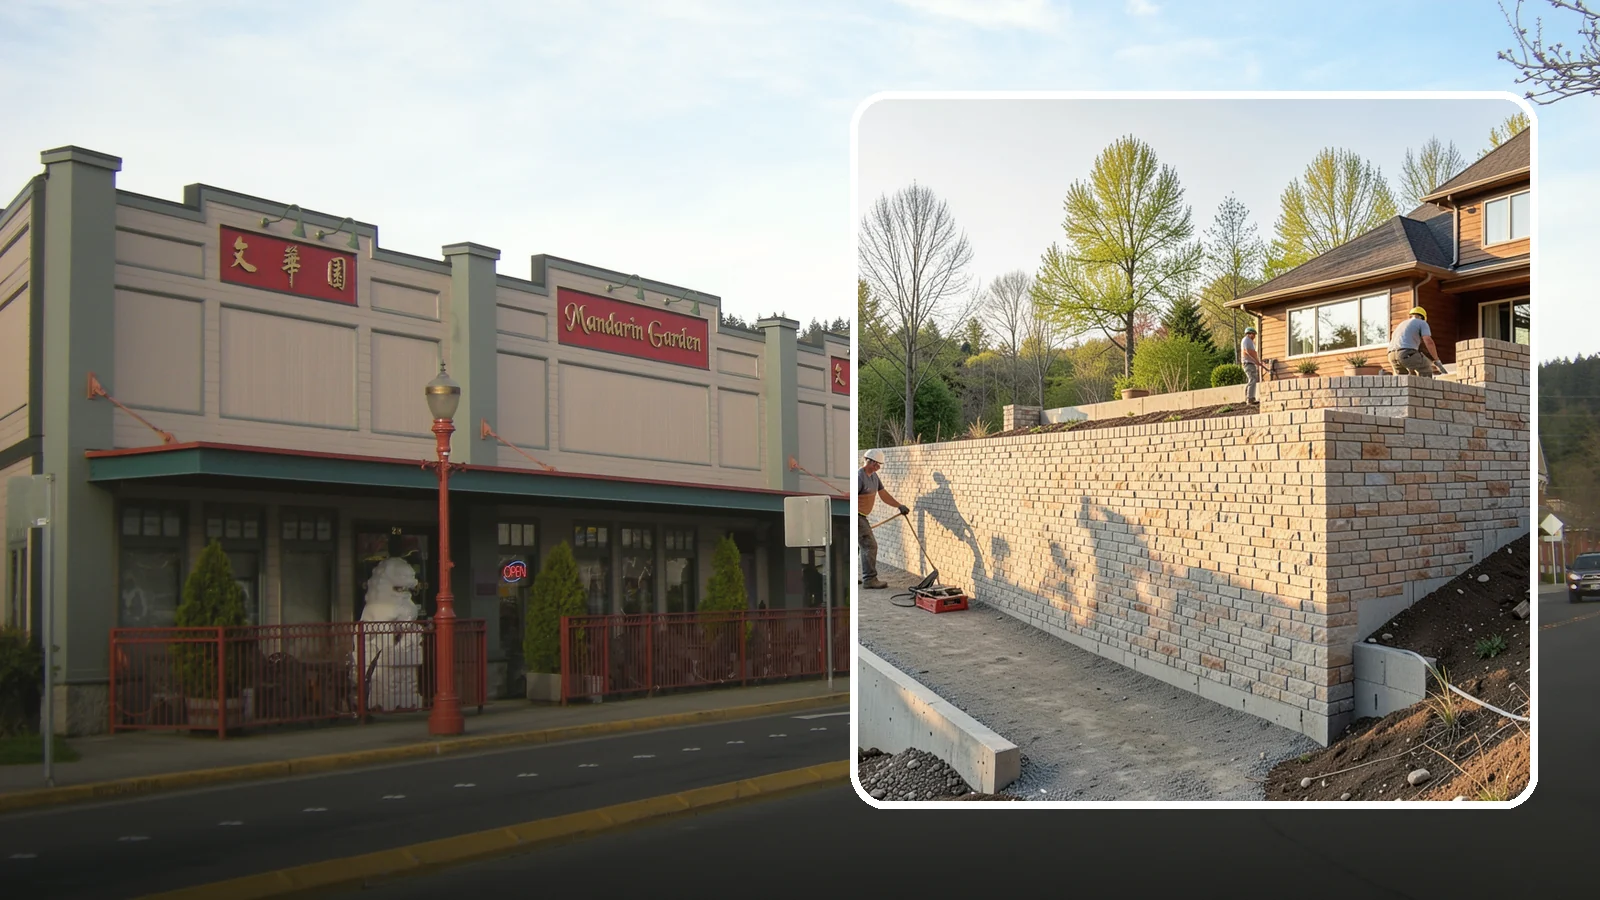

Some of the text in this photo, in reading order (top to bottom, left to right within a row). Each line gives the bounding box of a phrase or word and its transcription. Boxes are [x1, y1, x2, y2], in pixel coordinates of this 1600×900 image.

[564, 302, 700, 352] Mandarin Garden
[504, 565, 527, 578] OPEN
